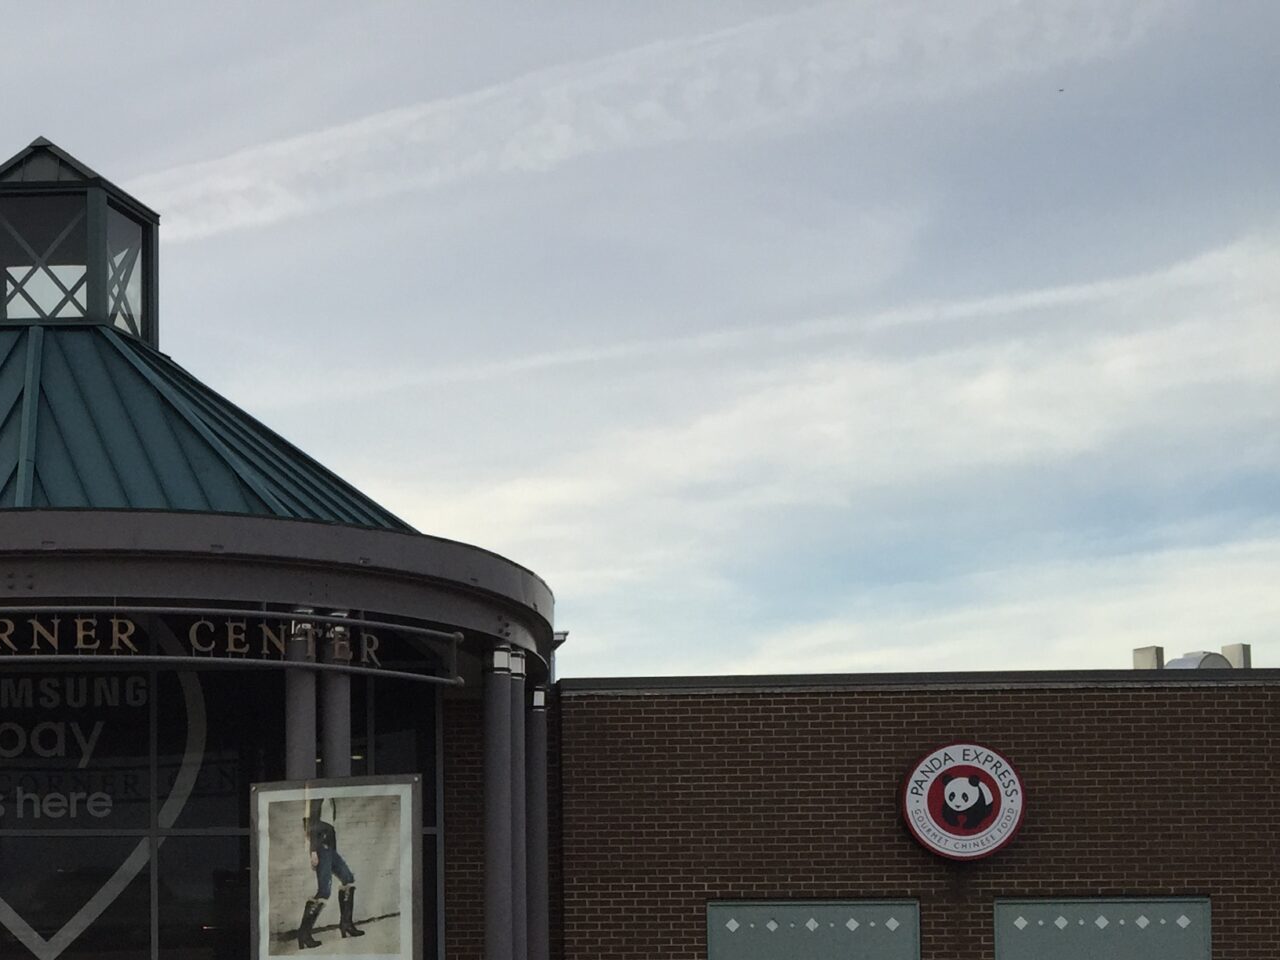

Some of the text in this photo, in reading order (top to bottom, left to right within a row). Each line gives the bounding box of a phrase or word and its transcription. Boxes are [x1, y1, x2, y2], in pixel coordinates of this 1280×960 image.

[189, 619, 382, 668] CENTER
[911, 749, 1019, 798] PANDA EXPRESS
[16, 785, 113, 820] here
[914, 807, 1015, 849] GOURMET CHINESE FOOD
